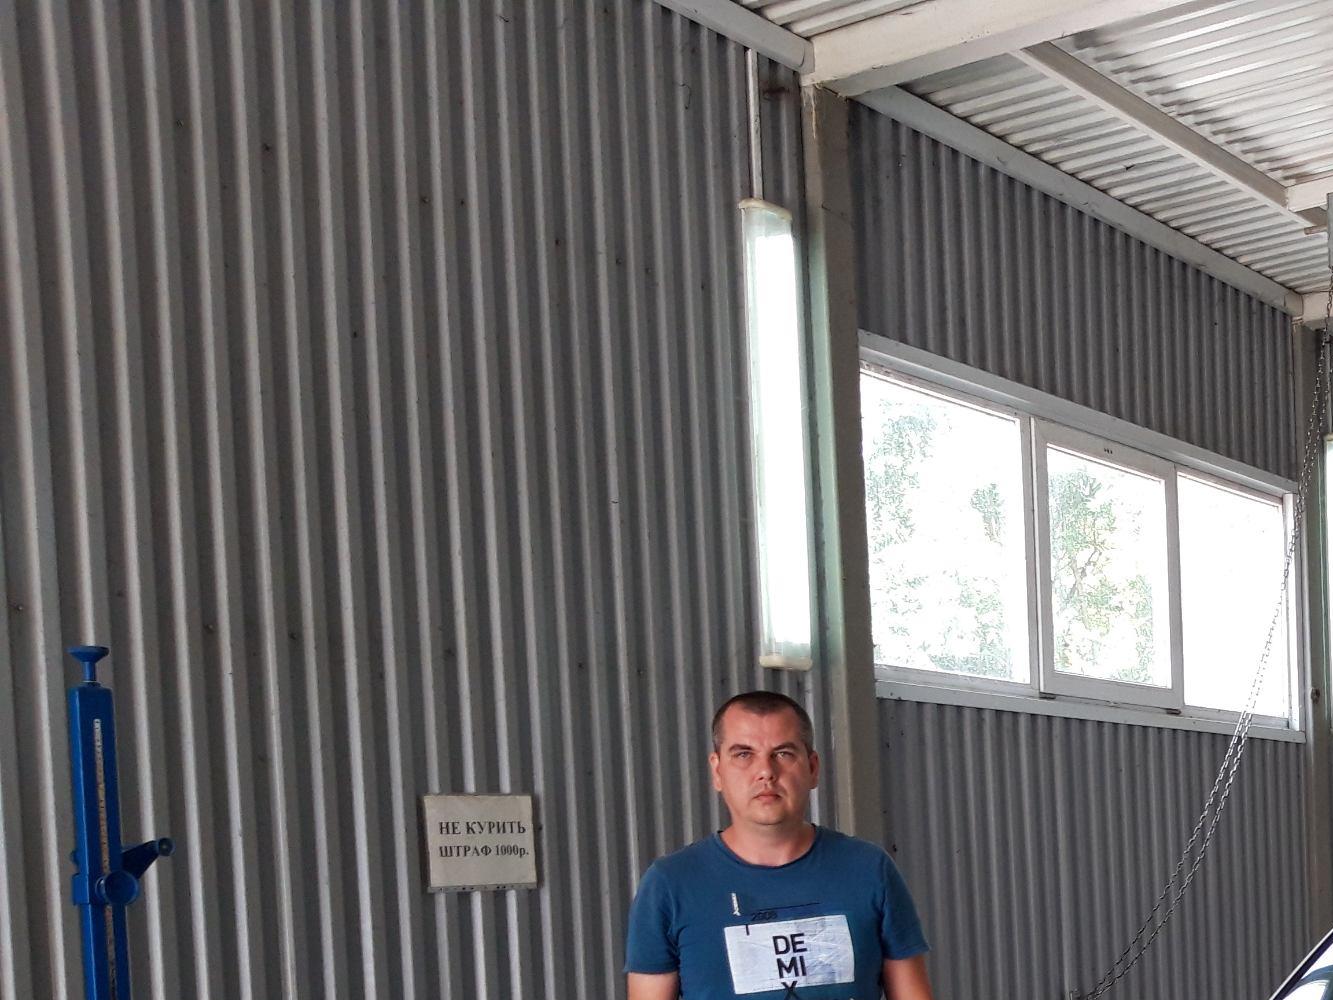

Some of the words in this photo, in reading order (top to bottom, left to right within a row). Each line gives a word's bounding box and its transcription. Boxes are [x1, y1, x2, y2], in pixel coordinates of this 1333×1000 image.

[439, 821, 461, 835] НЕ
[466, 820, 527, 835] КУРИТЬ
[439, 845, 492, 858] ШТРАФ
[495, 844, 529, 858] 1000р.
[772, 933, 807, 956] DE
[776, 955, 807, 979] MI
[781, 980, 800, 1000] X
